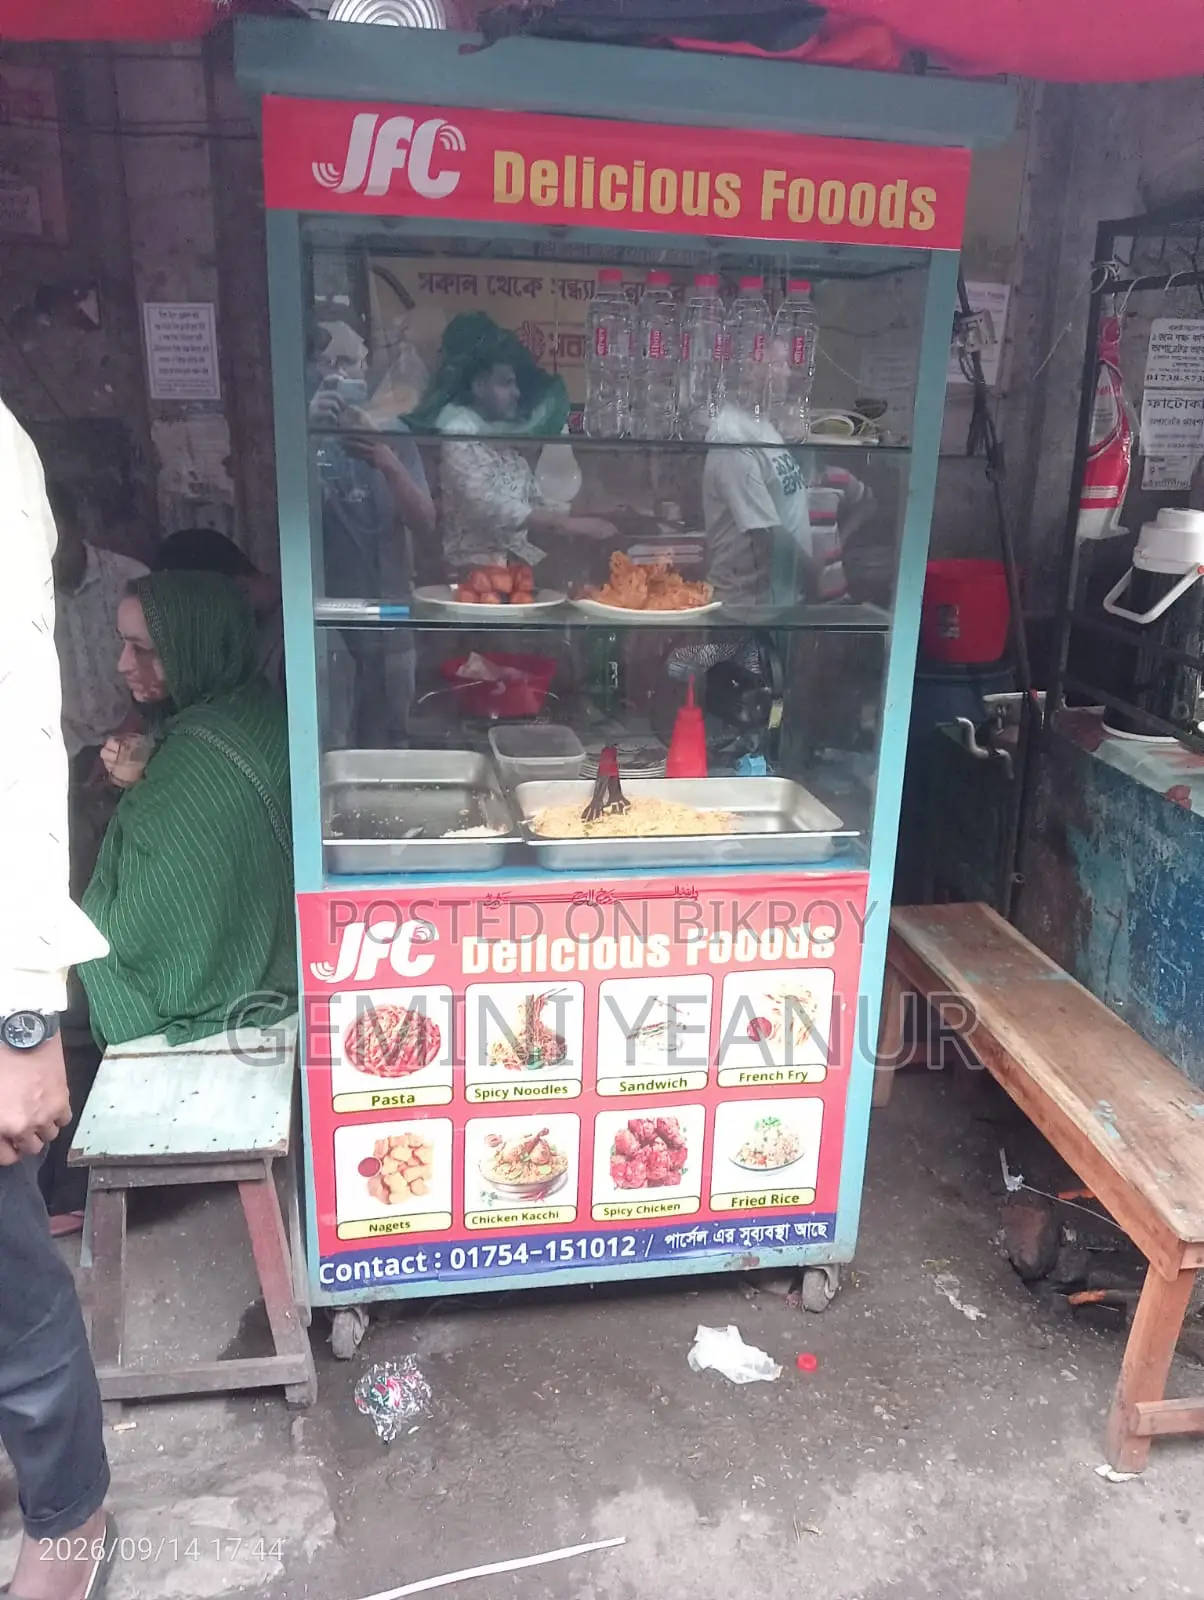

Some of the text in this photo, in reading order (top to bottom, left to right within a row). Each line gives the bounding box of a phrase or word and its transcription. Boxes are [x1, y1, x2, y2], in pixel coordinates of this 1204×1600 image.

[312, 113, 937, 232] JFC Delicious Fooods
[418, 271, 478, 297] সকাল
[485, 274, 543, 299] থেকে
[310, 919, 836, 984] JFC Delicious Fooods
[739, 1069, 809, 1084] French Fry
[619, 1077, 688, 1092] Sandwich
[371, 1092, 416, 1107] Pasta
[474, 1084, 568, 1101] Spicy Noodles
[731, 1193, 800, 1208] Fried Rice
[471, 1210, 559, 1225] Chicken Kacchi
[603, 1202, 681, 1218] Spicy Chicken
[369, 1219, 411, 1234] Nagets
[319, 1250, 428, 1285] Contact
[450, 1235, 636, 1270] 01754-151012
[664, 1225, 709, 1249] পার্সেল
[713, 1227, 736, 1244] এর
[740, 1223, 791, 1247] সুব্যবস্থা
[793, 1221, 829, 1240] আছে
